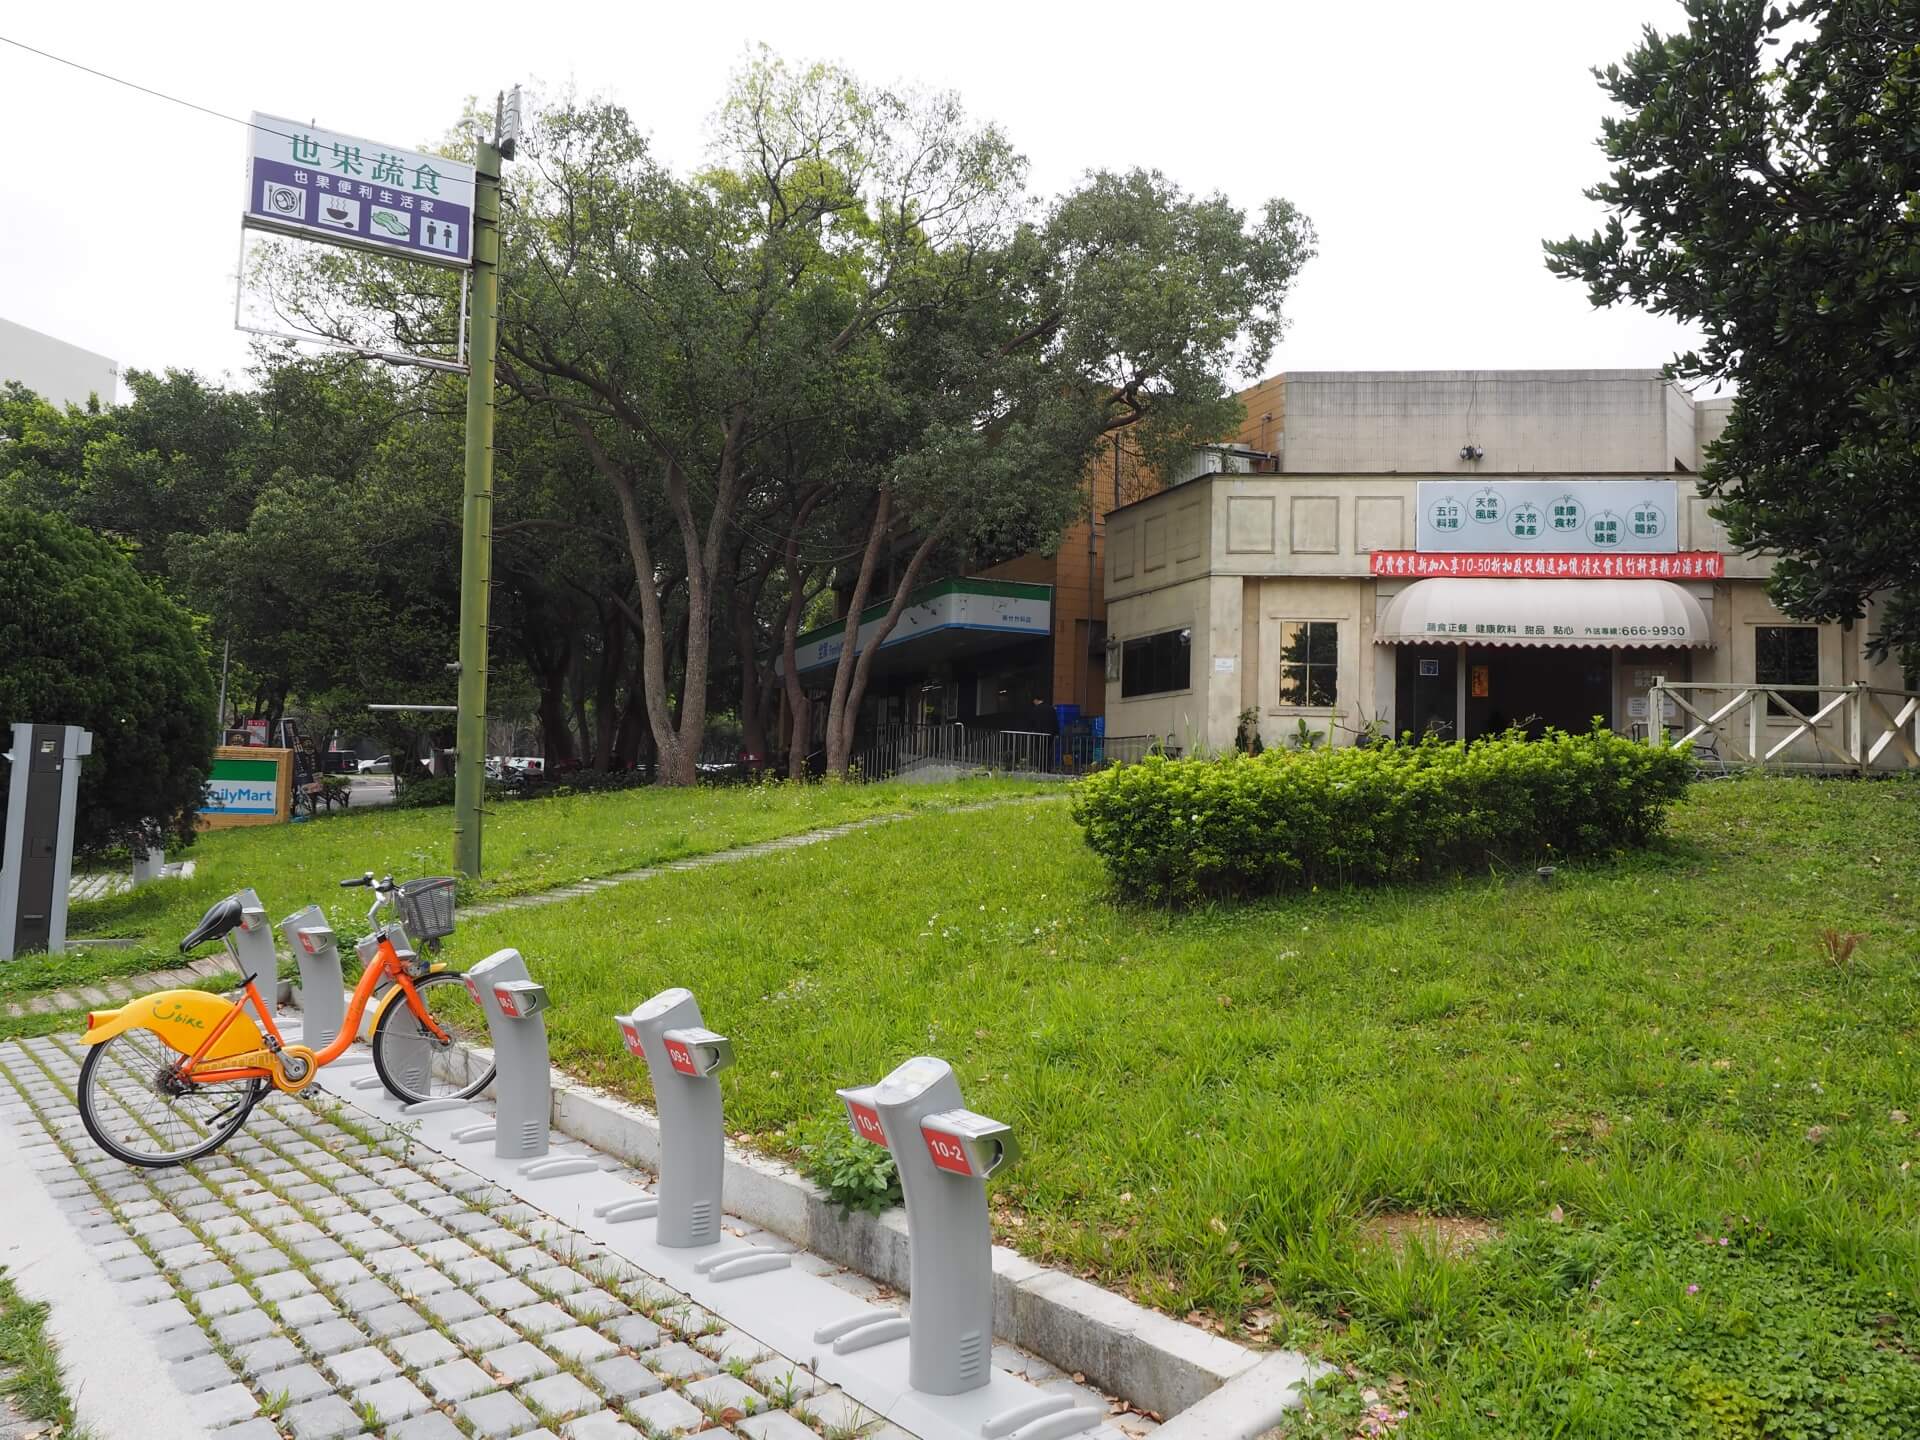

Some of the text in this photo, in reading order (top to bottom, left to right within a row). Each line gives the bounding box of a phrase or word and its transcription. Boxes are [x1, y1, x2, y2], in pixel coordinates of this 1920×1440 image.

[290, 134, 441, 195] 也果蔬食
[294, 169, 435, 214] 也果便利生活家
[1475, 497, 1498, 508] 天然
[1436, 506, 1459, 517] 五行
[1475, 509, 1498, 520] 風味
[1554, 505, 1577, 516] 健康
[1436, 518, 1459, 529] 料理
[1515, 513, 1537, 524] 天然
[1554, 518, 1577, 528] 食材
[1524, 625, 1545, 635] 甜品
[1553, 625, 1575, 635] 點心
[670, 1048, 691, 1065] 09-2
[857, 1113, 884, 1136] 10-1
[931, 1138, 965, 1162] 10-2
